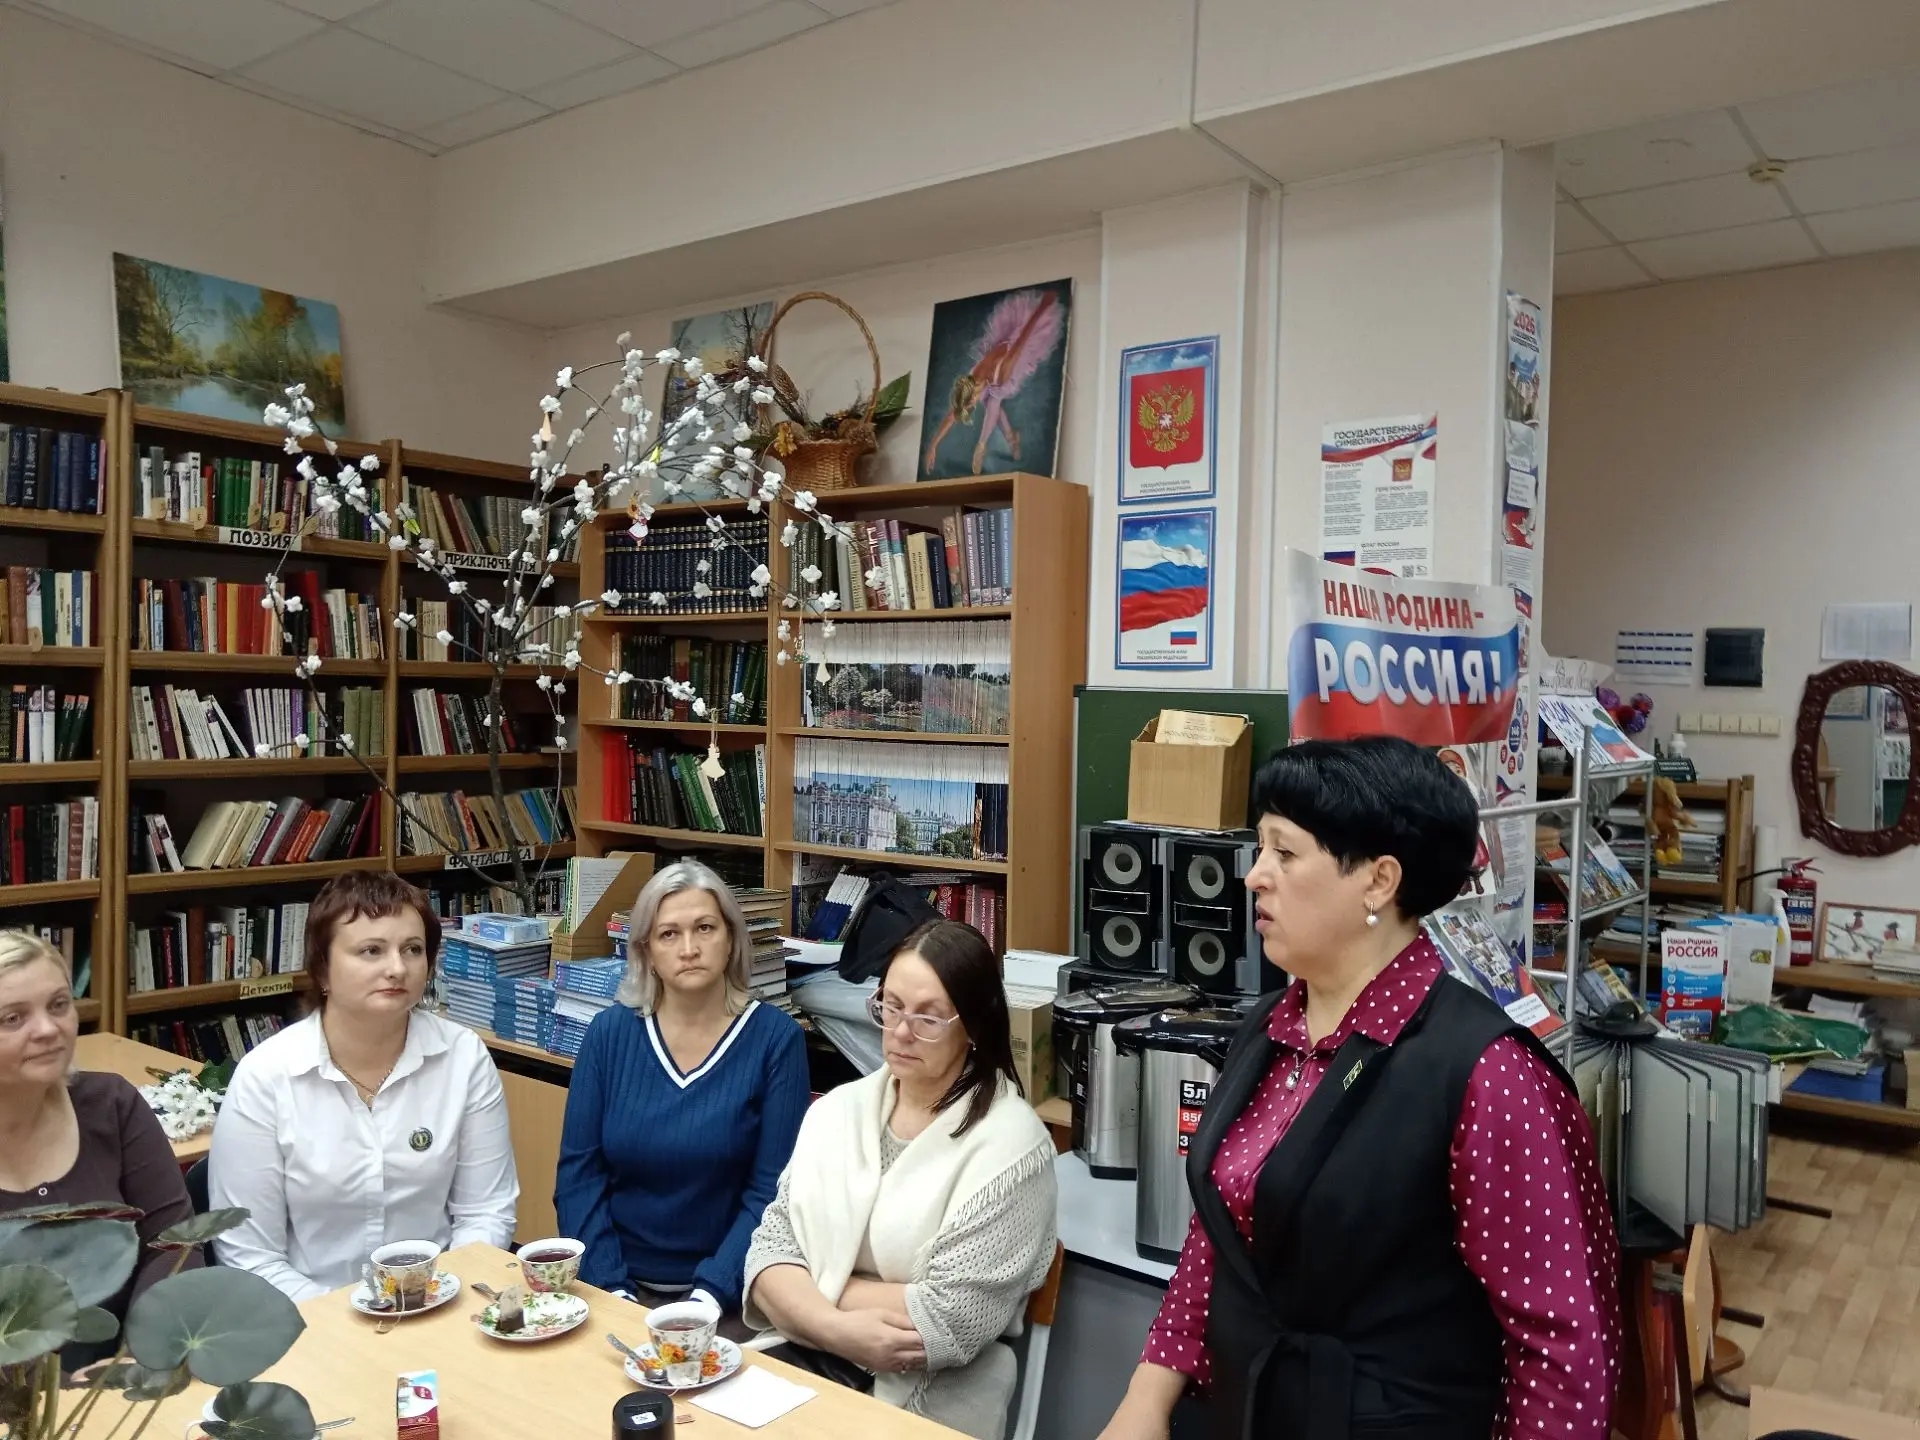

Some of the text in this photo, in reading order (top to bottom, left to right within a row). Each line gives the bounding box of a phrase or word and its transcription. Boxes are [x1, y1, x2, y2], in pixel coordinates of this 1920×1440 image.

[1333, 424, 1425, 440] ГОСУДАРСТВЕННАЯ
[1334, 436, 1386, 448] СИМВОЛИКА
[229, 530, 292, 548] ПОЭЗИЯ
[445, 553, 537, 572] ПРИКЛЮЧЕИЯ
[1323, 579, 1382, 624] НАША
[1314, 637, 1502, 705] РОССИЯ!
[449, 848, 531, 867] ФНТАСТИА
[1667, 946, 1718, 957] РОССИЯ
